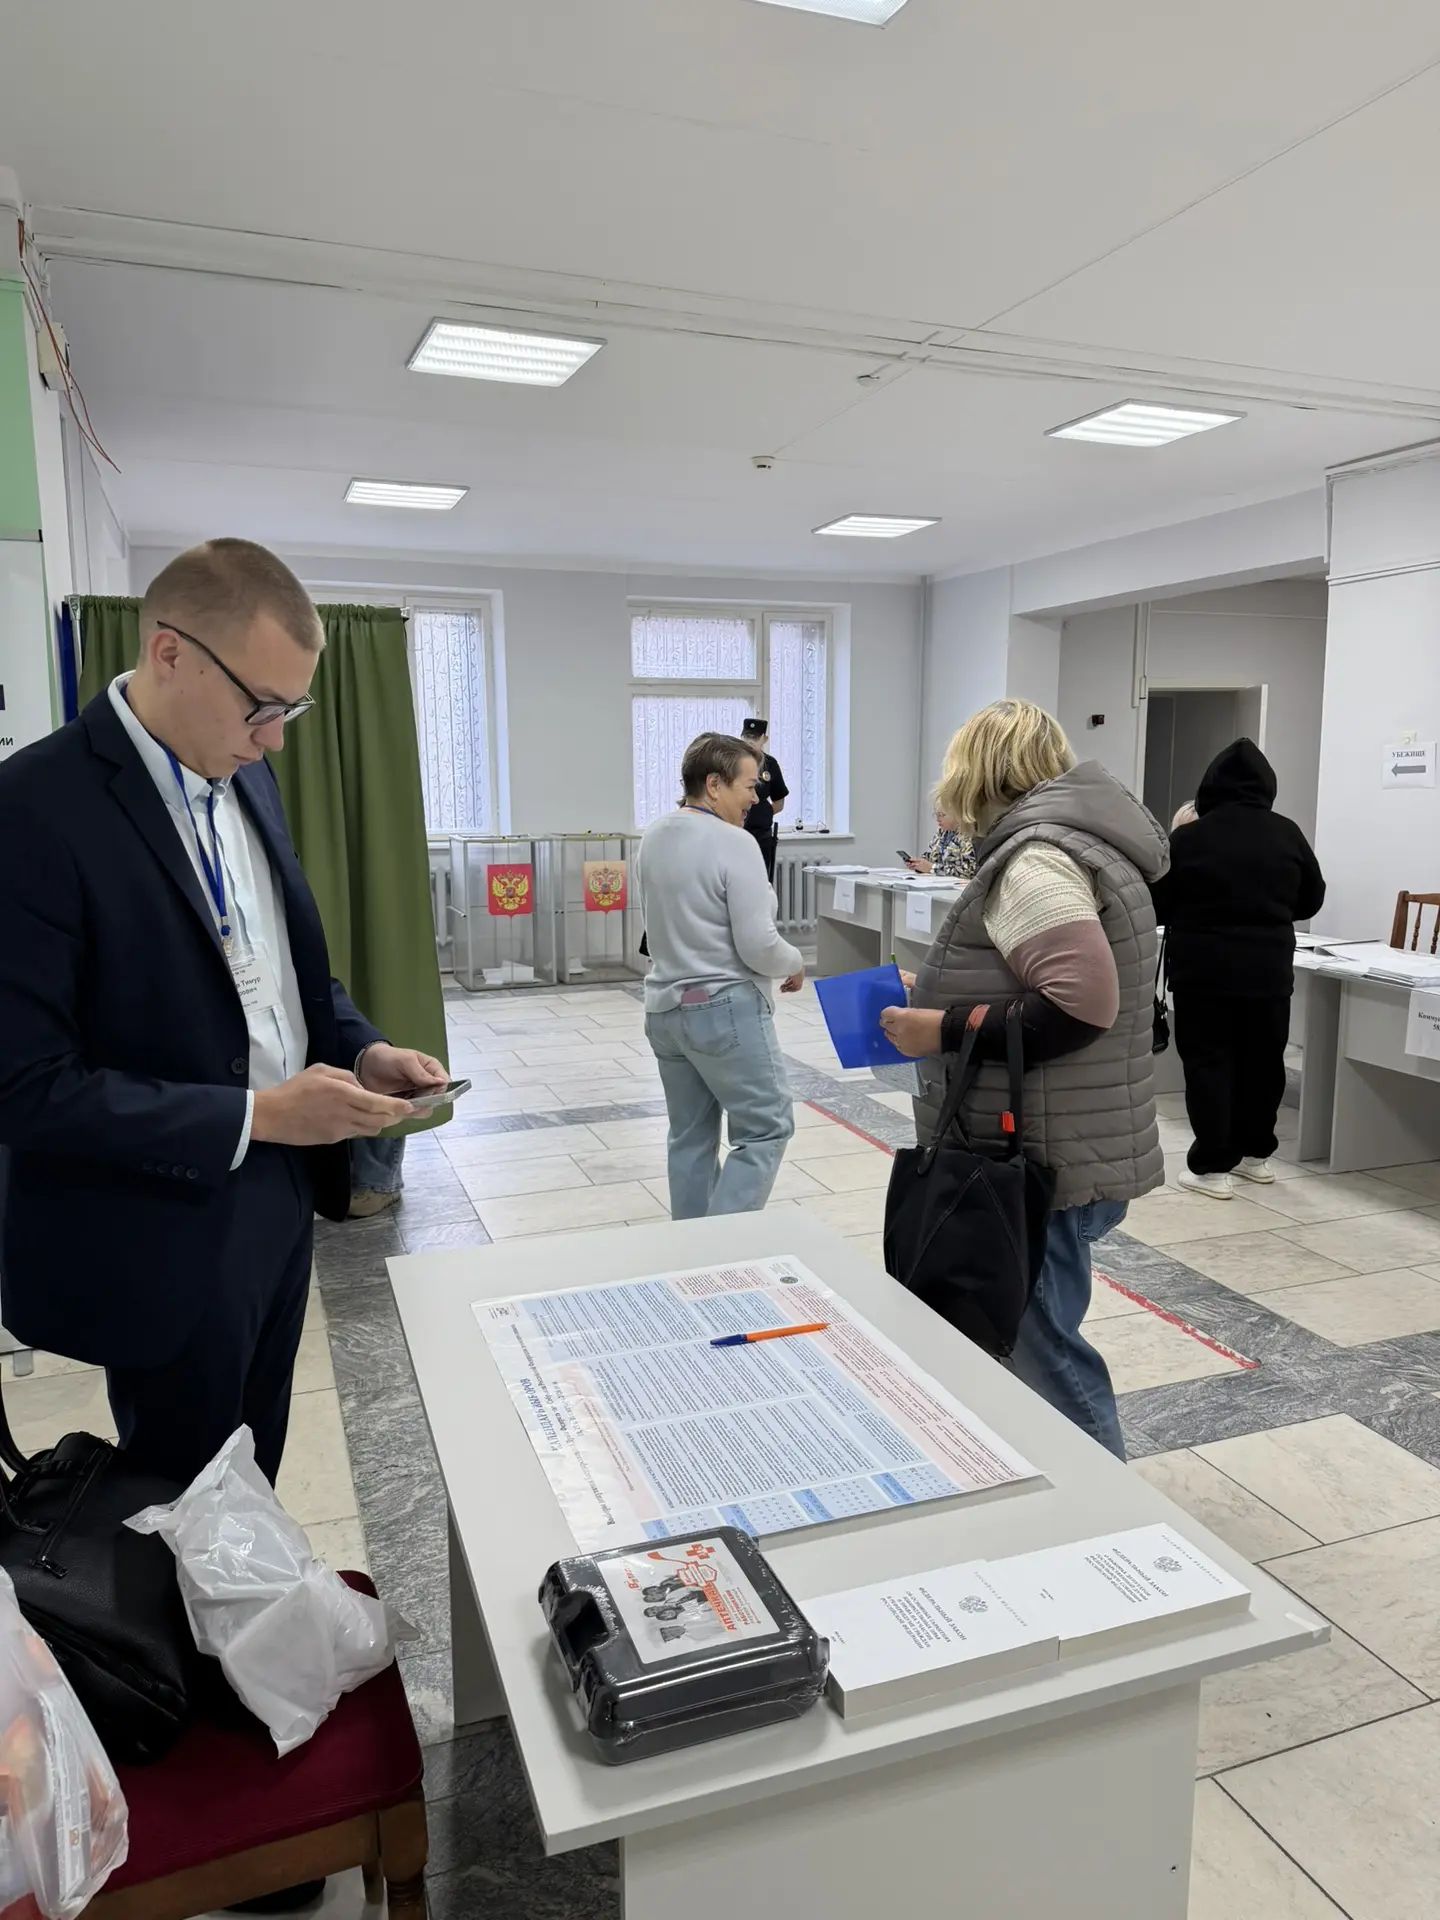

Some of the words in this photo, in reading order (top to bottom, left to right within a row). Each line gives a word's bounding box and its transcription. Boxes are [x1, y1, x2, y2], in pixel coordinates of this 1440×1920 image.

[1392, 750, 1425, 758] УБЕЖИЩЕ
[241, 976, 261, 986] Тимур
[519, 1377, 542, 1409] ВЫБОРОВ
[533, 1407, 563, 1451] КАЛЕНДАРЬ
